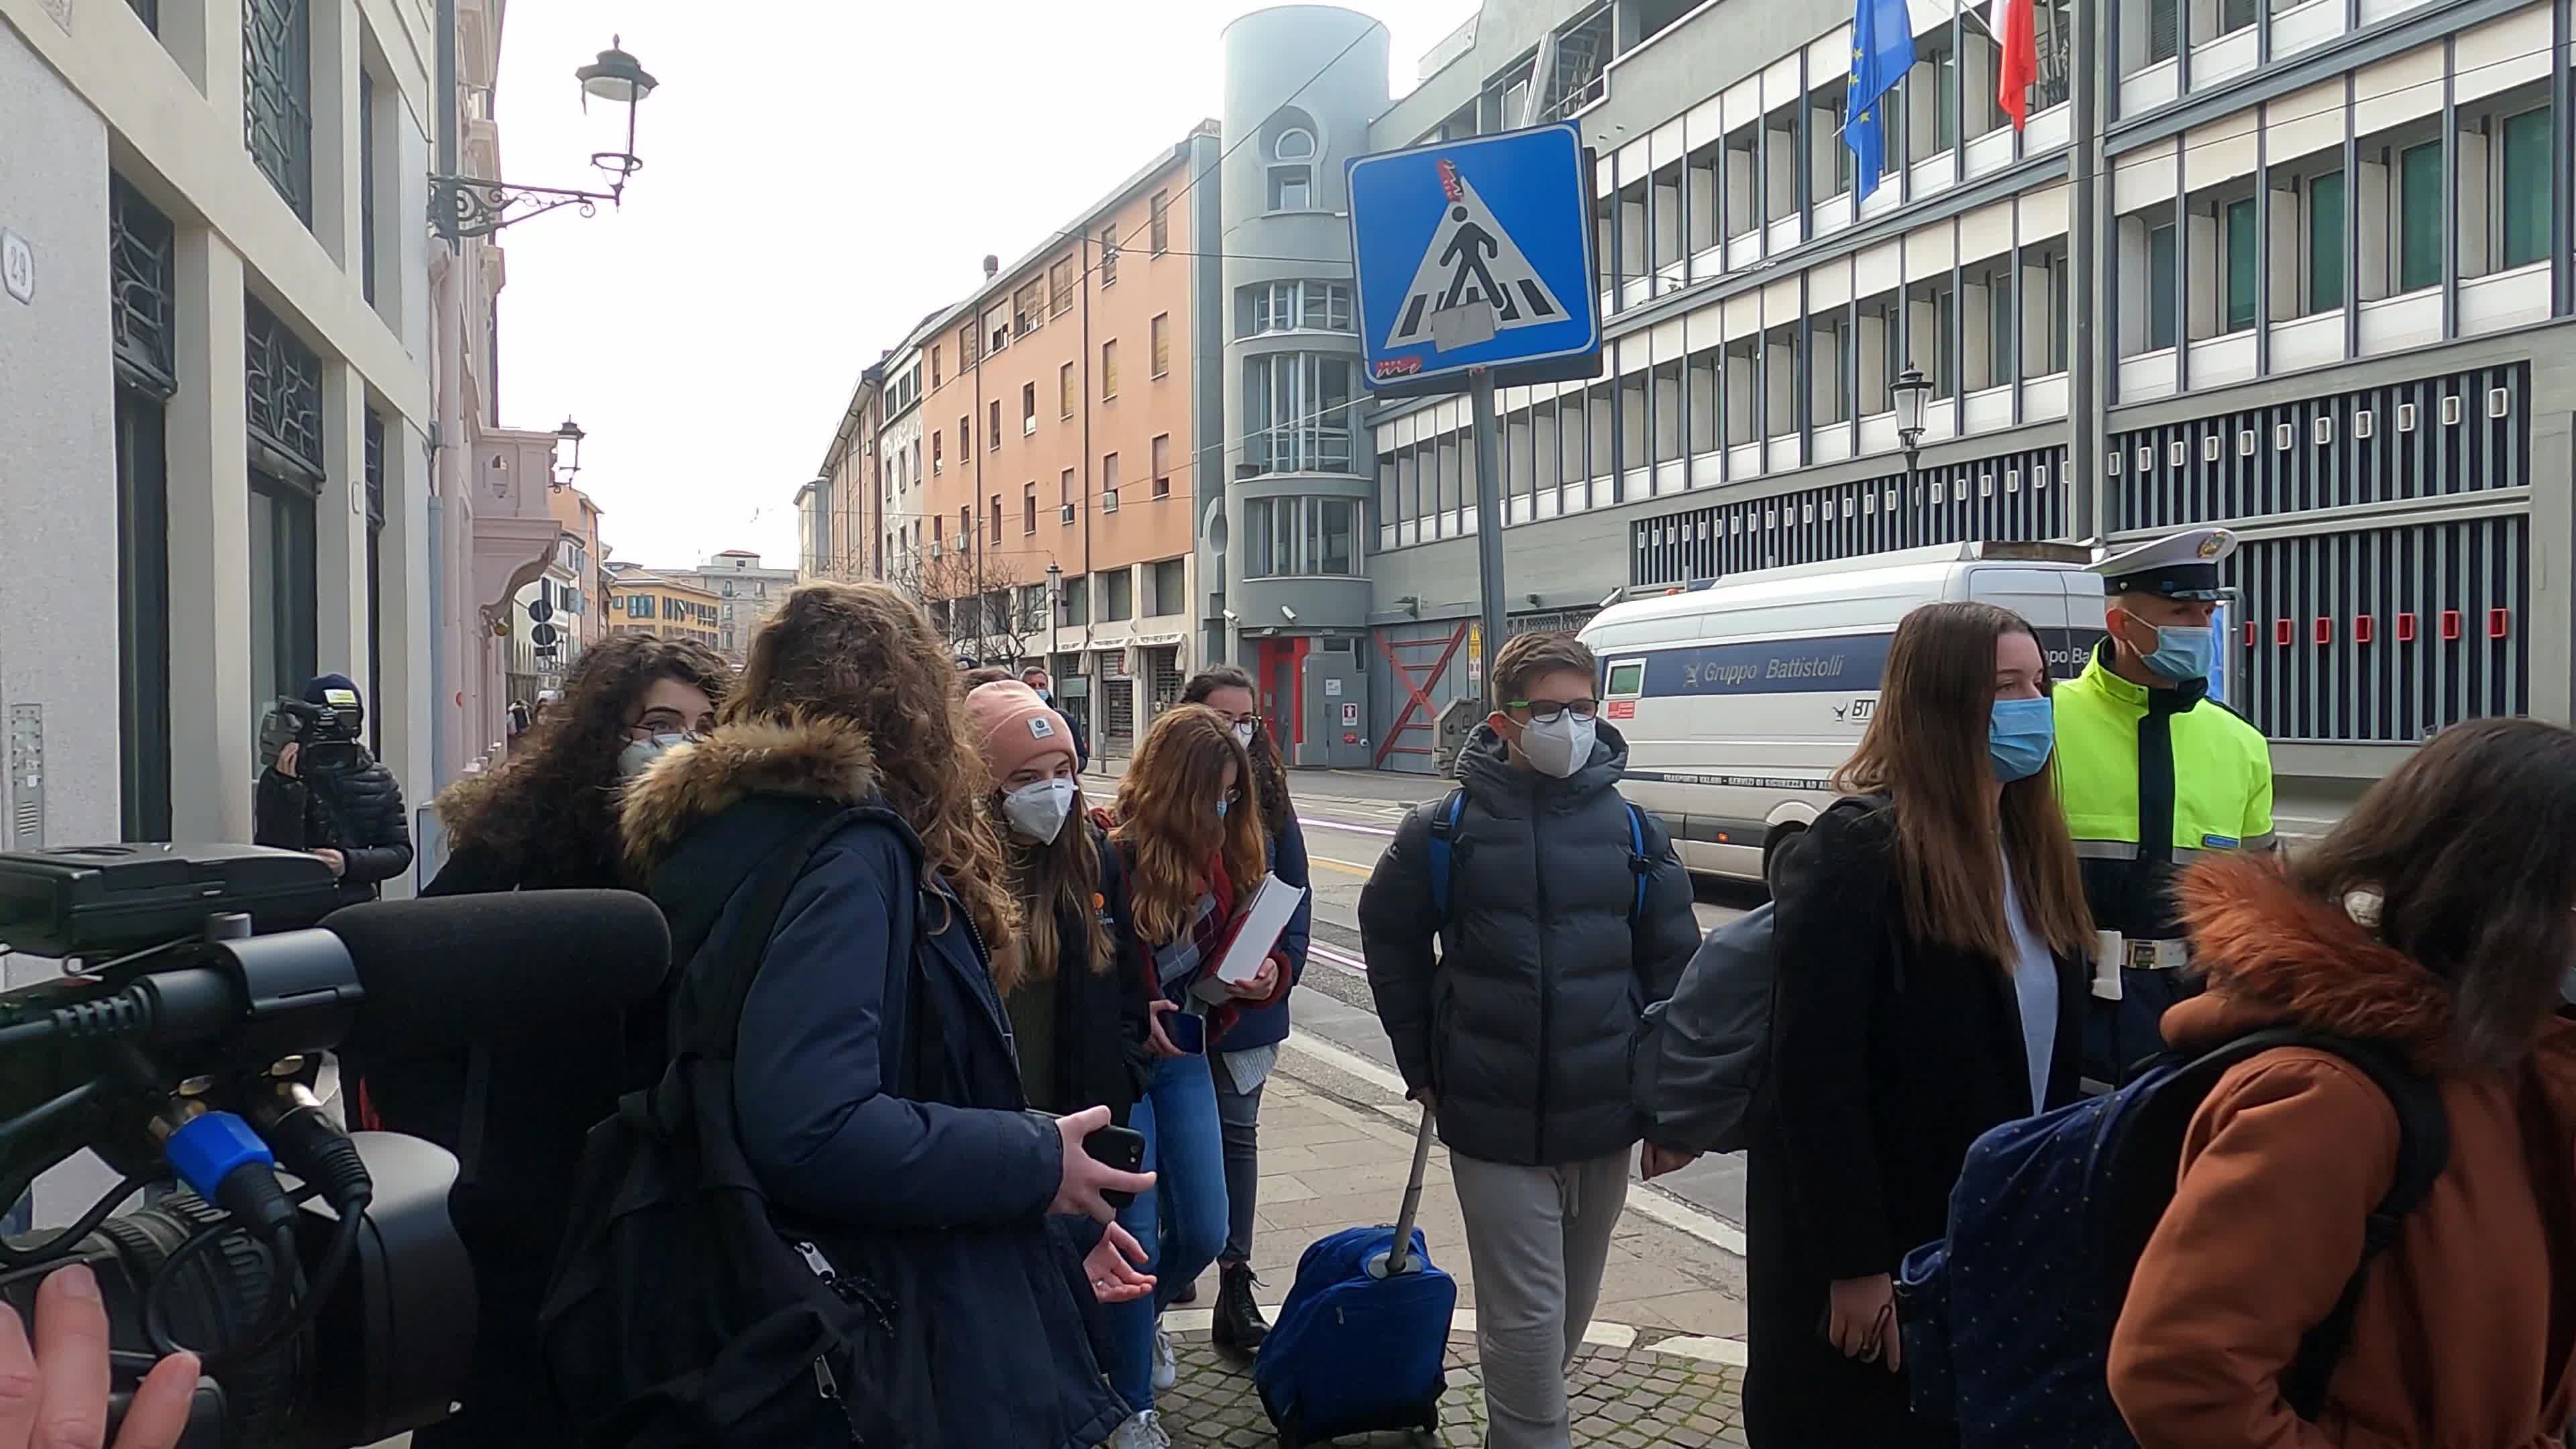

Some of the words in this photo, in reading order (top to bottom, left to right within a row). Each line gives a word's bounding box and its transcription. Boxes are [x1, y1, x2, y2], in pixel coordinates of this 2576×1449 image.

[10, 246, 27, 287] 29
[1705, 661, 1758, 685] Gruppo
[1765, 654, 1844, 679] Battistolli
[2072, 647, 2092, 664] Ba
